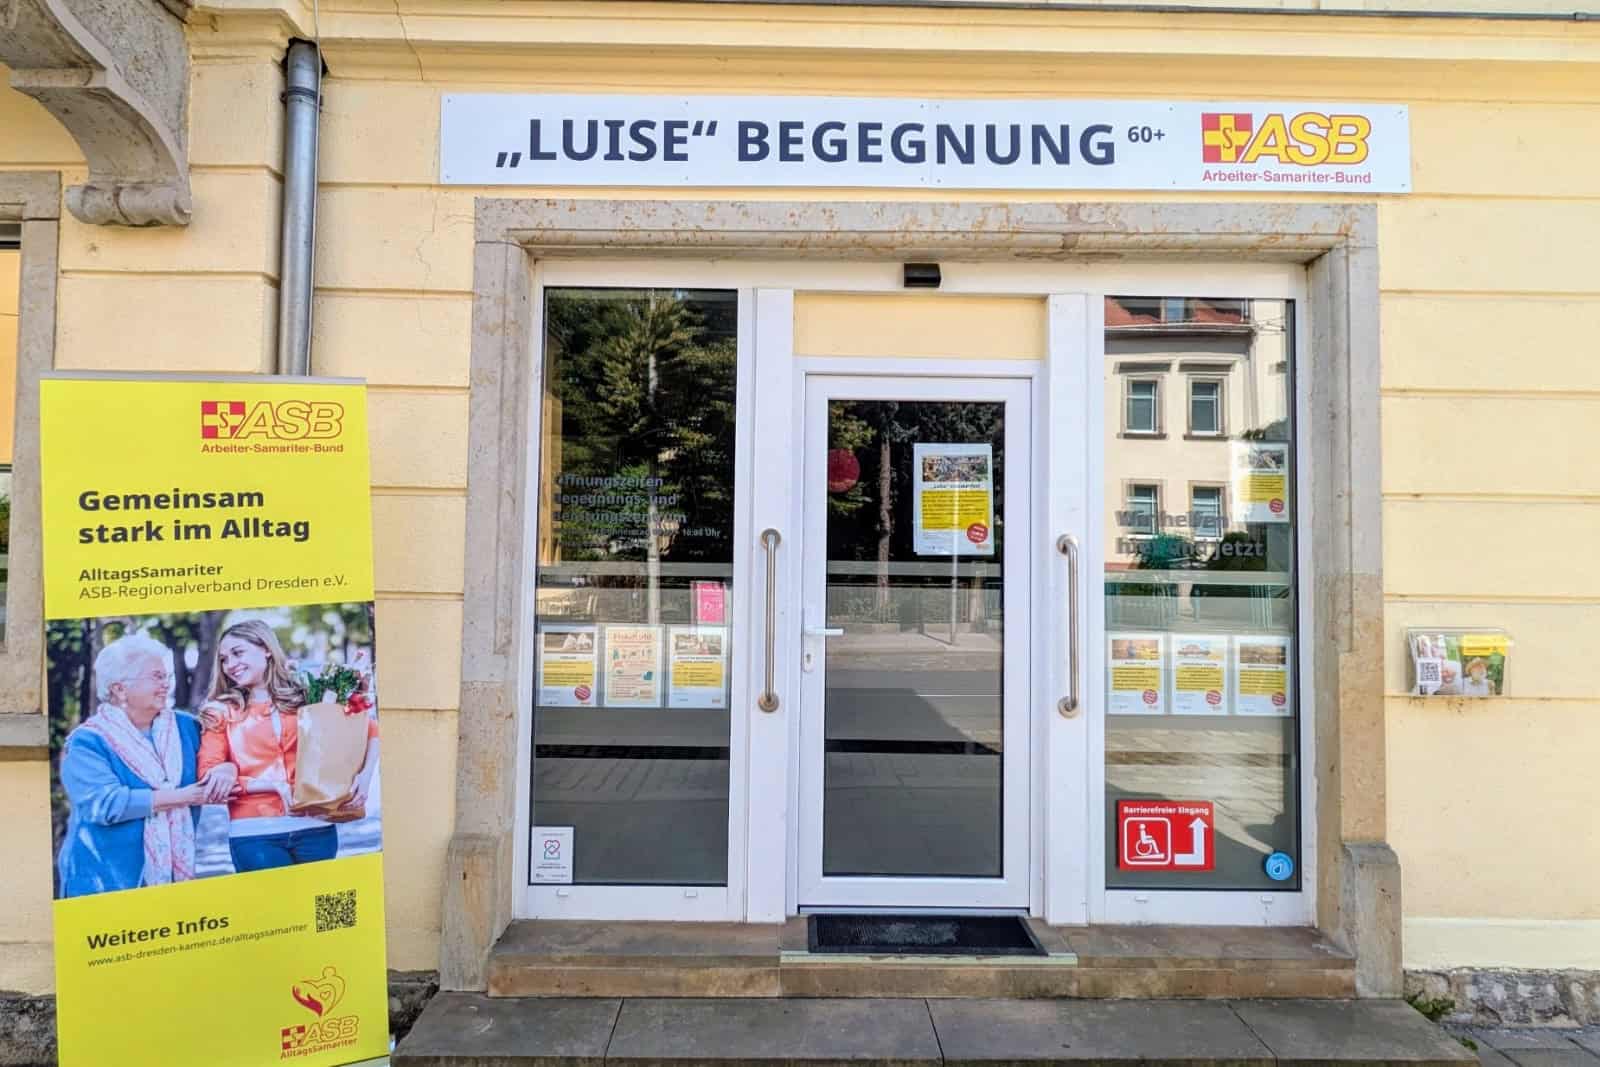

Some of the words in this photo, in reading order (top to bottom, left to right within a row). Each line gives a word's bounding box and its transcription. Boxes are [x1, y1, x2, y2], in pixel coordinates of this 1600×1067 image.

[495, 118, 718, 168] „LUISE“
[737, 120, 1116, 166] BEGEGNUNG
[1127, 125, 1166, 144] 60+
[1239, 112, 1372, 166] ASB
[1202, 169, 1372, 184] Arbeiter-Samariter-Bund
[233, 400, 345, 440] ASB
[201, 443, 344, 454] Arbeiter-Samariter-Bund
[78, 488, 264, 512] Gemeinsam
[78, 520, 163, 544] stark
[173, 520, 211, 541] im
[221, 517, 310, 542] Alltag
[1212, 539, 1265, 560] jetzt
[78, 563, 224, 583] AlltagsSamariter
[78, 579, 252, 600] ASB-Regionalverband
[256, 575, 320, 592] Dresden
[323, 574, 348, 587] e.V.
[1123, 806, 1177, 815] Barrierefreier
[1178, 806, 1209, 816] Eingang
[87, 925, 171, 950] Weitere
[176, 915, 230, 936] Infos
[87, 923, 309, 968] www.asb-dresden-kamenz.de/alltagssamariter
[305, 1015, 360, 1046] ASB
